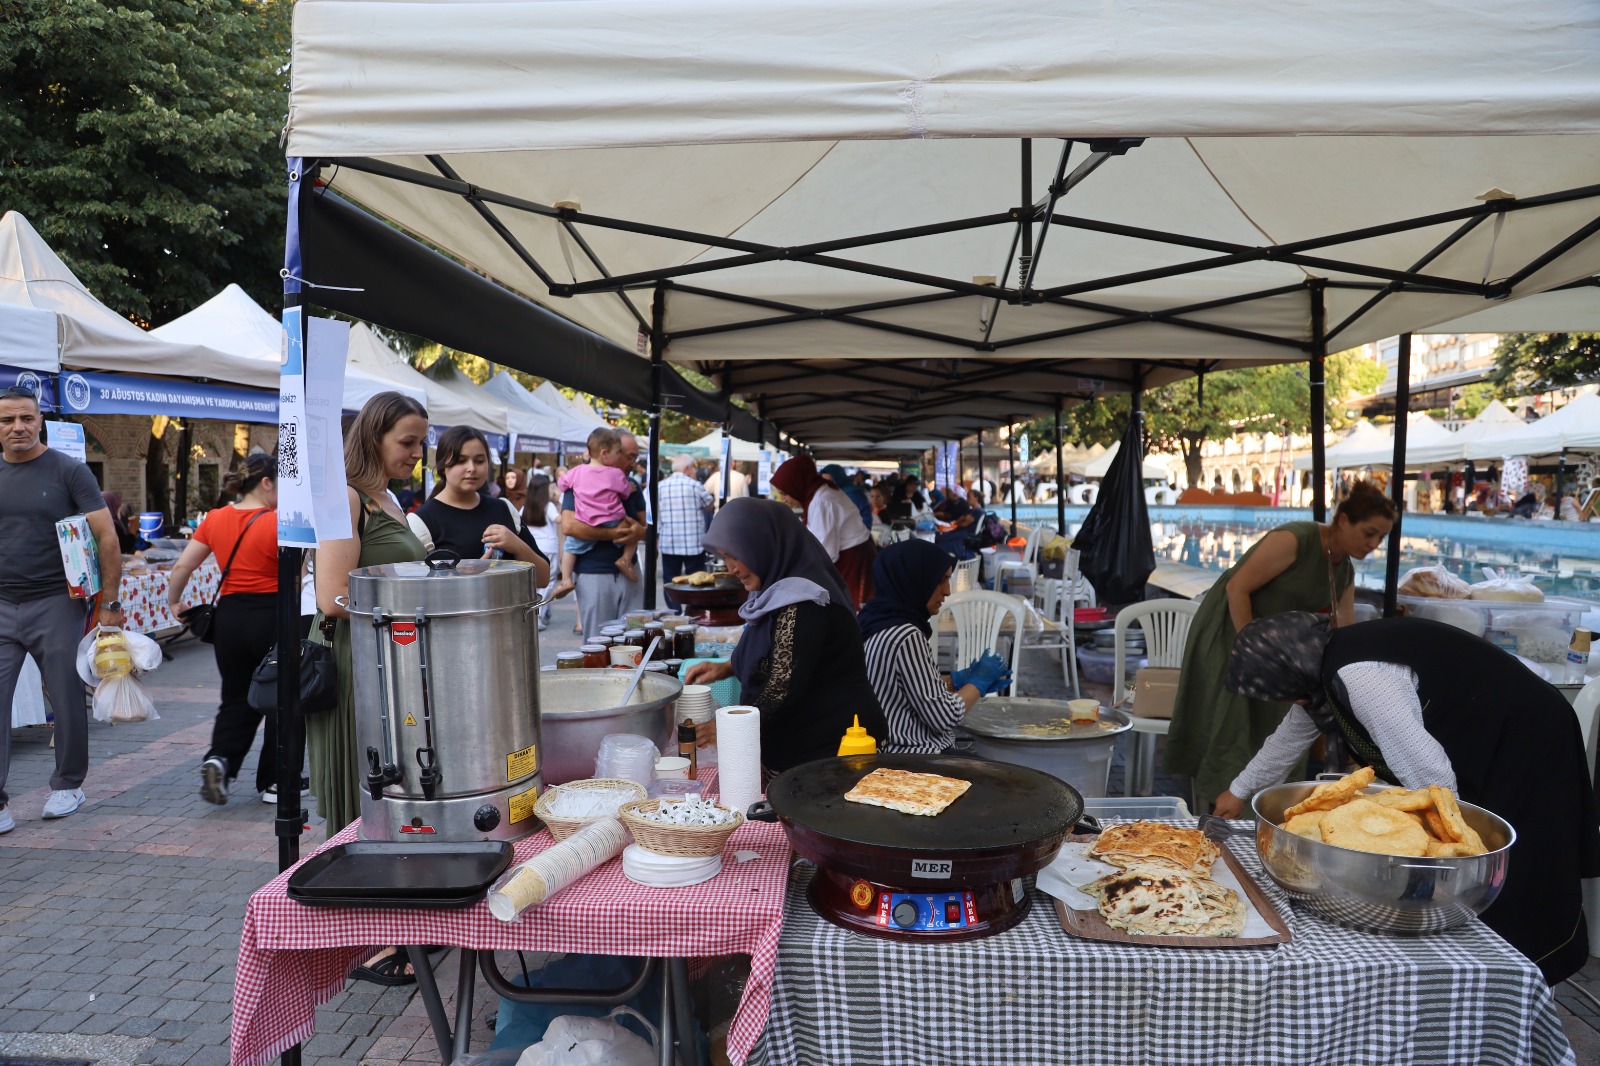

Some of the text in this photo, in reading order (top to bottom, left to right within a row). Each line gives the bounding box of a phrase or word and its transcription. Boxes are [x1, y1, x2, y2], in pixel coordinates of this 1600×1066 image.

[100, 388, 110, 399] 30
[111, 387, 145, 401] AĞUSTOS
[146, 392, 168, 403] KADIN
[168, 394, 205, 406] DAYANIŞMA
[205, 396, 214, 406] VE
[214, 397, 254, 410] YARDIMLAŞMA
[914, 862, 950, 873] MER
[880, 902, 889, 924] MER
[966, 900, 975, 922] MER
